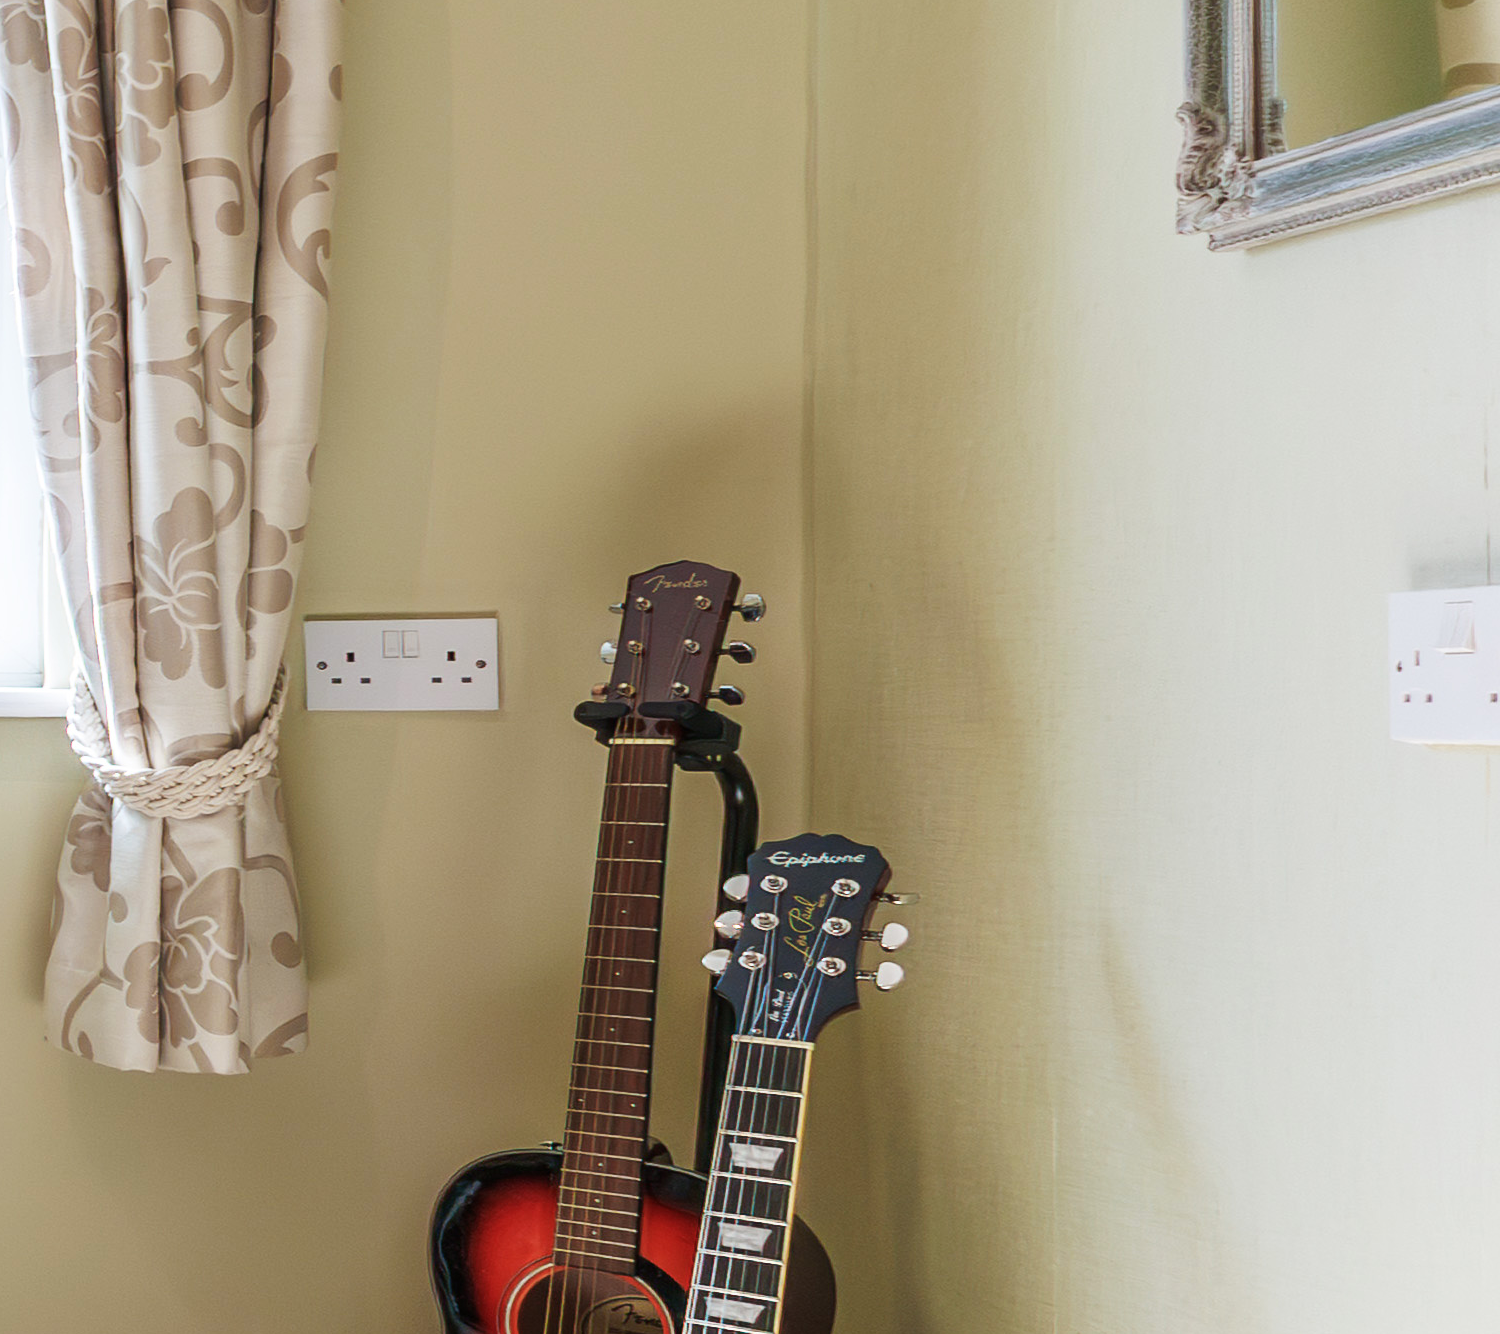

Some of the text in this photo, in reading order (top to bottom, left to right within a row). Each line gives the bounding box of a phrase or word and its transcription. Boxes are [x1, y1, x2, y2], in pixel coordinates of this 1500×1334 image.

[644, 572, 708, 594] Fender
[766, 851, 866, 868] Epiphone
[784, 895, 819, 968] Les Paul
